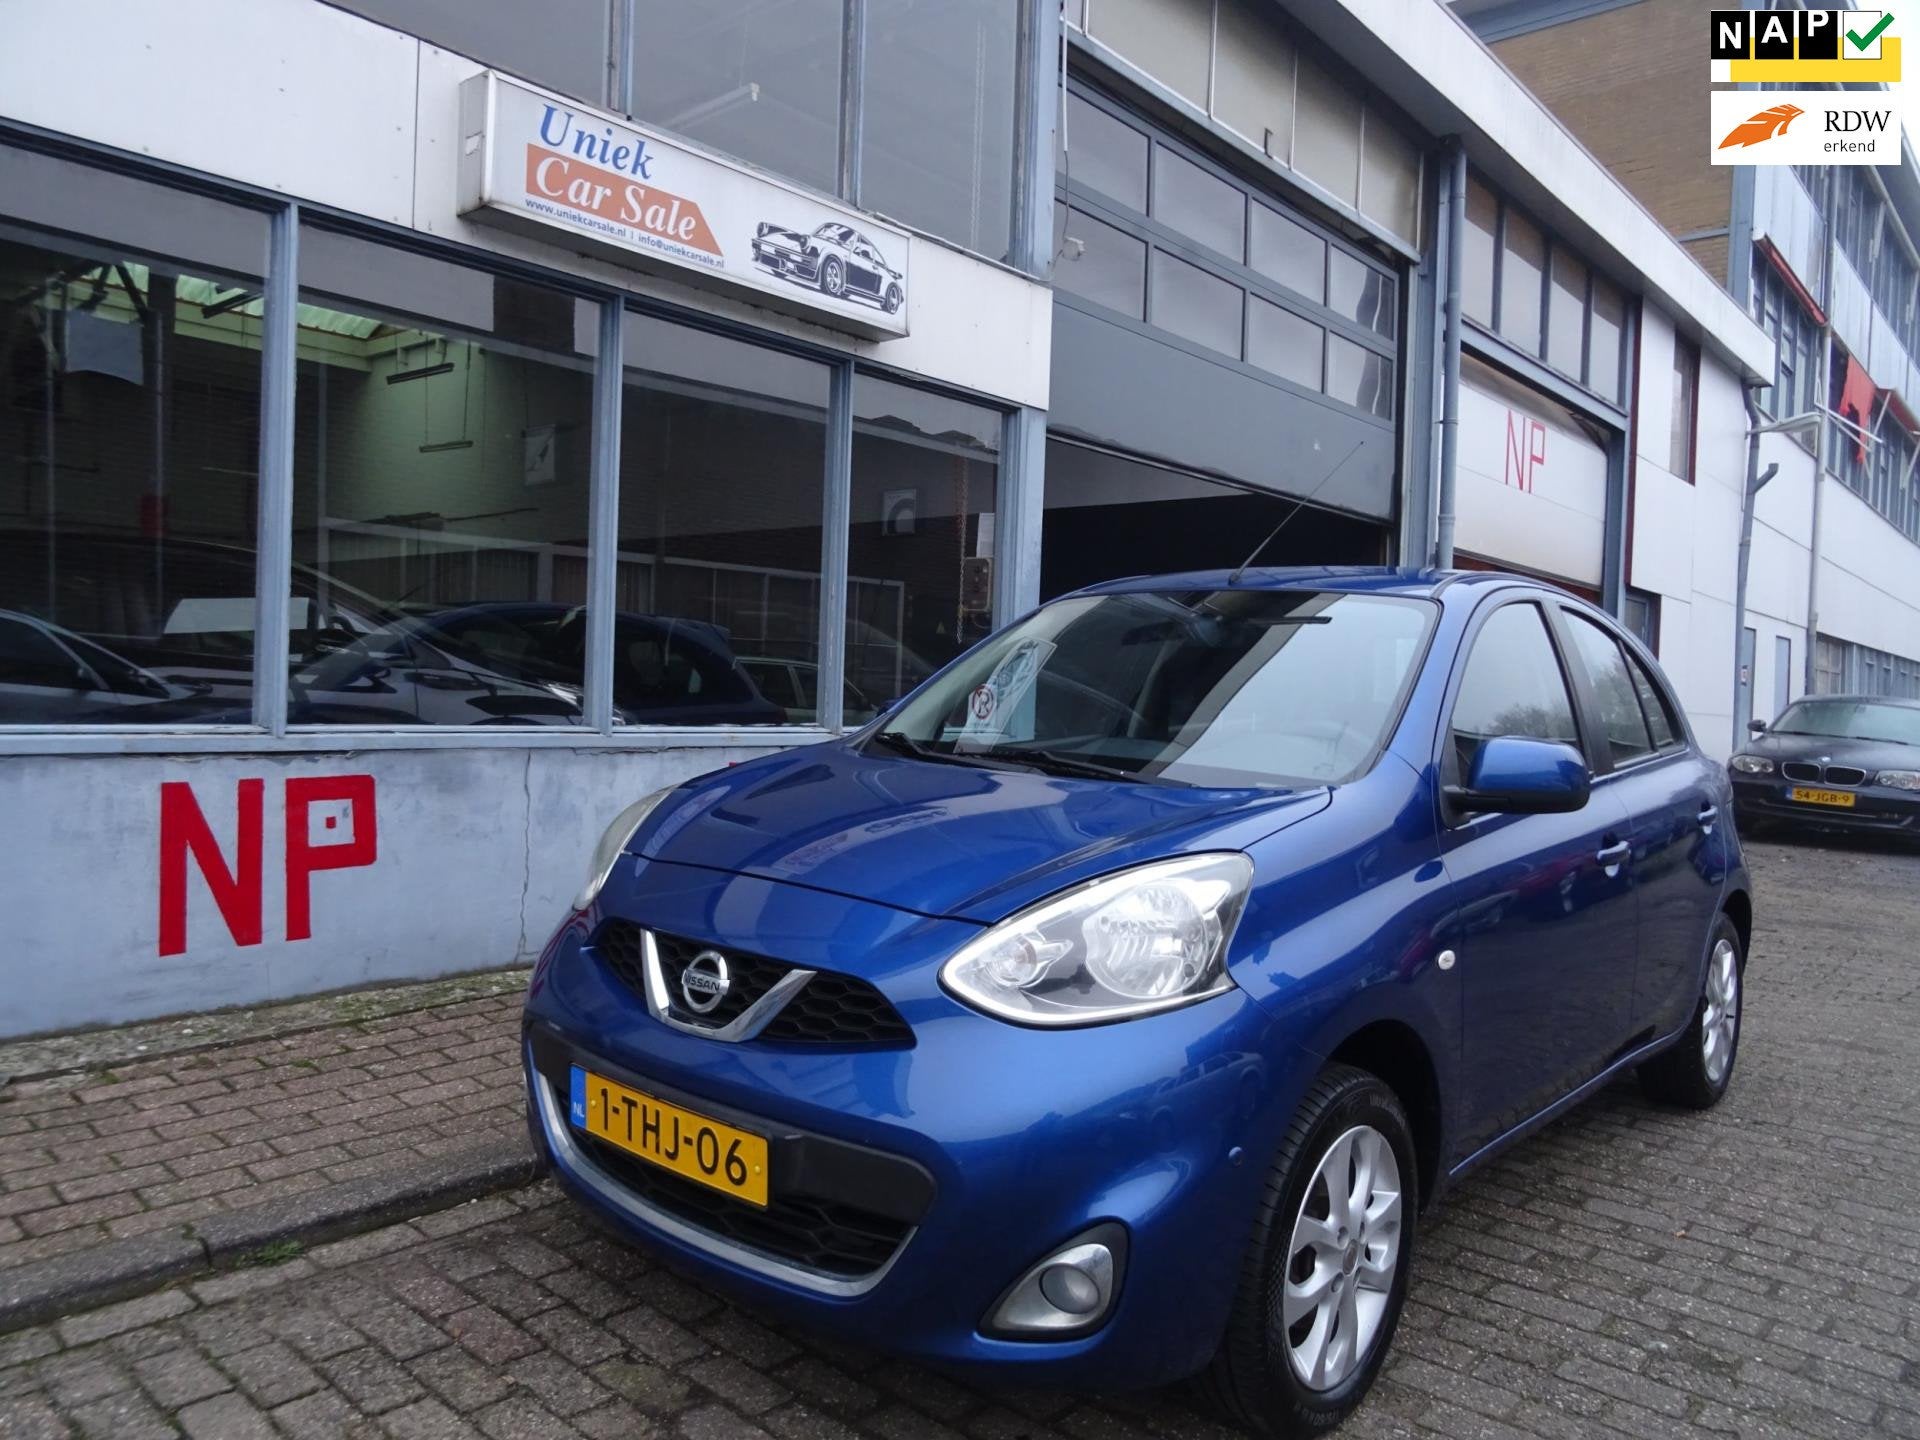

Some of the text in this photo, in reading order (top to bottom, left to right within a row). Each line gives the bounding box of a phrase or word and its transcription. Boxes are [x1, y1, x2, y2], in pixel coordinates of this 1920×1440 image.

[540, 103, 653, 180] Uniek
[525, 199, 725, 268] www.uniekcarsale.nl info@uniekcarsale.nl
[536, 157, 697, 241] Car Sale
[1505, 410, 1546, 494] NP
[159, 774, 377, 957] NP
[684, 973, 721, 991] NISSAN
[573, 1101, 585, 1118] NL
[601, 1088, 747, 1186] 1-THJ-06
